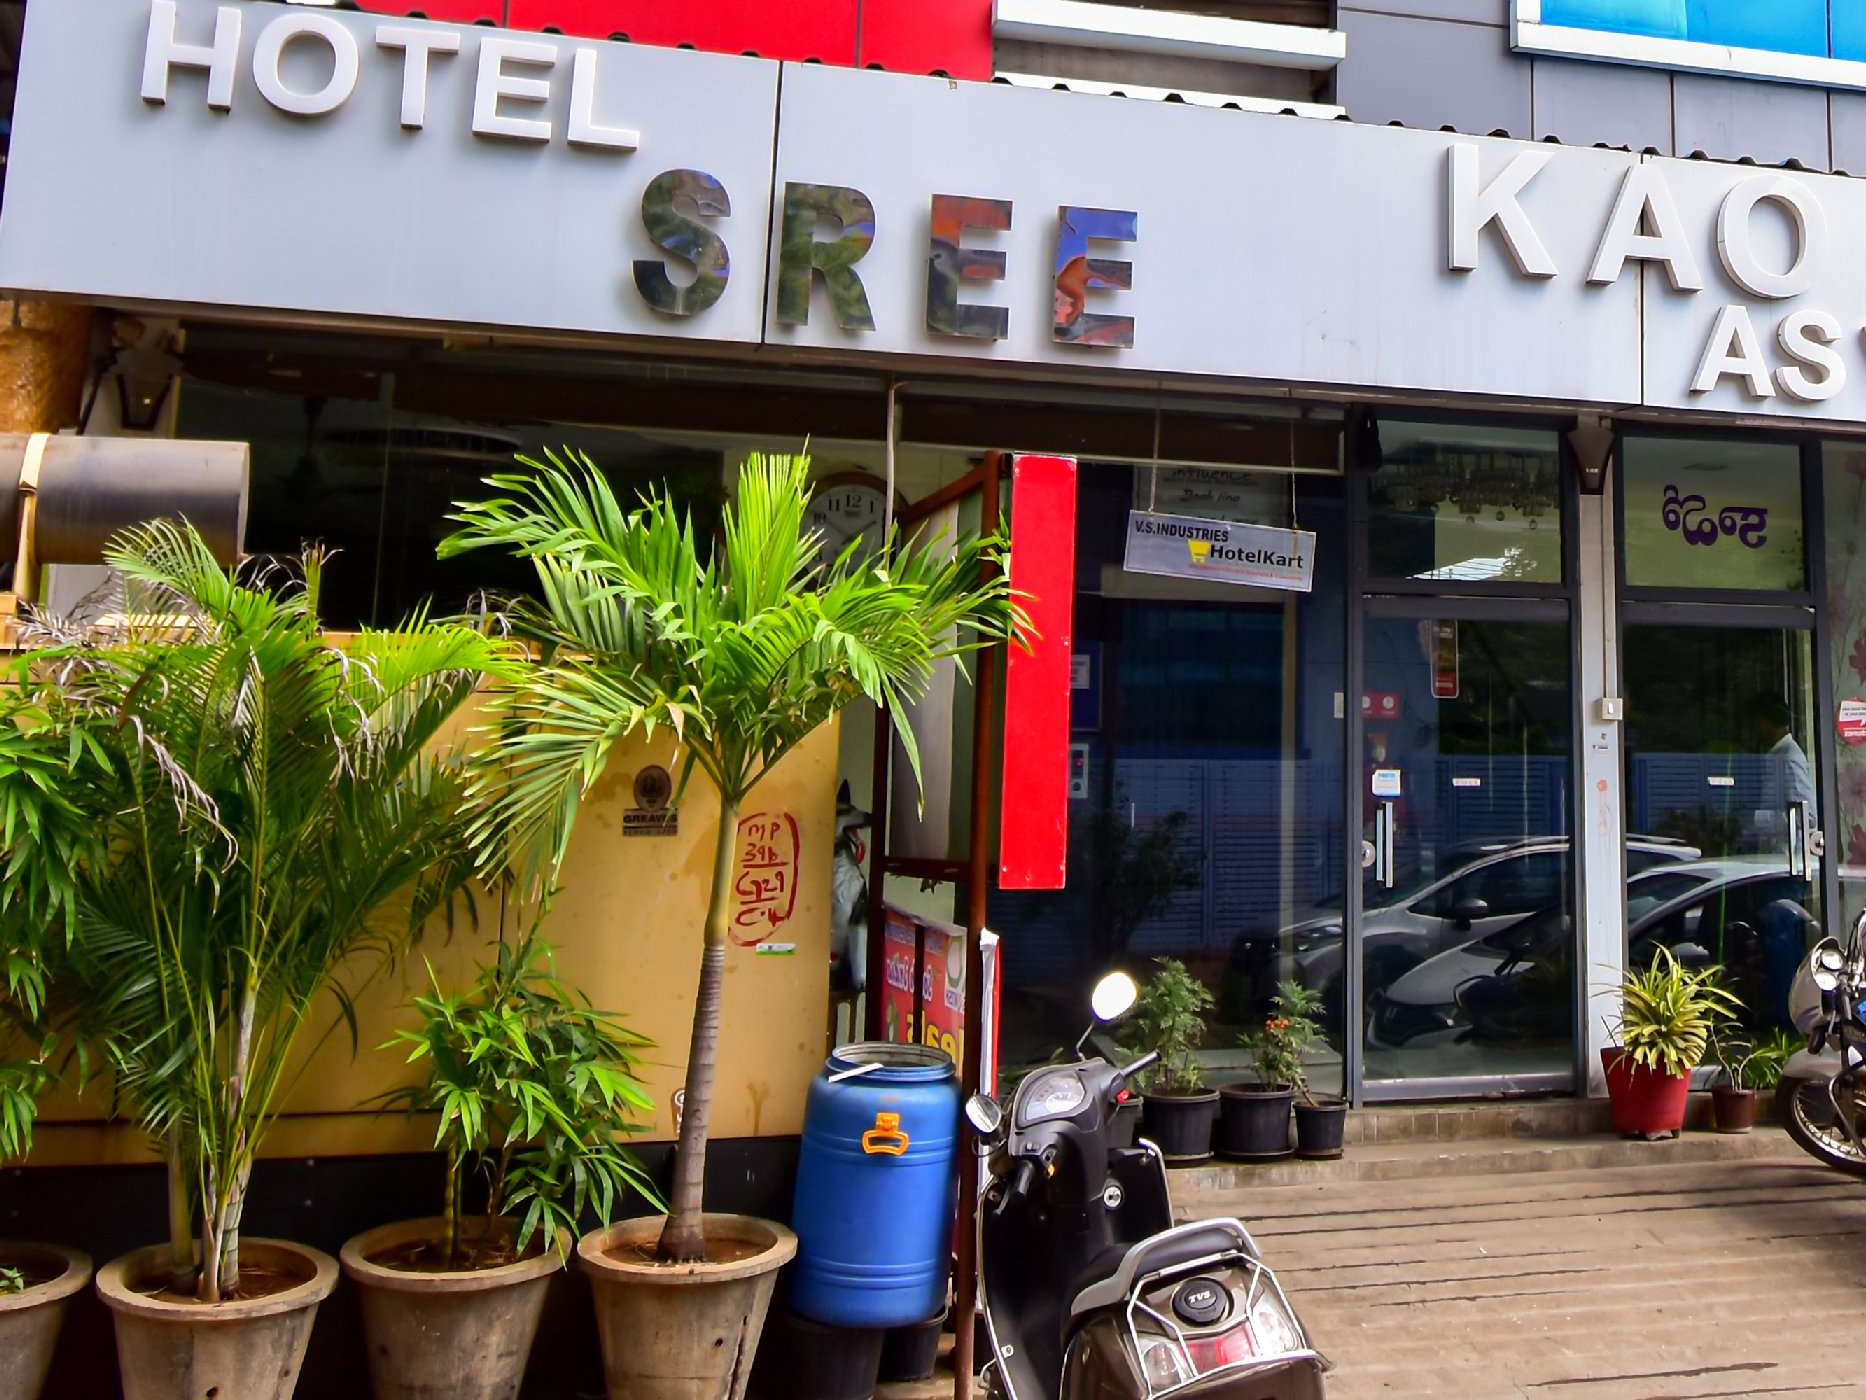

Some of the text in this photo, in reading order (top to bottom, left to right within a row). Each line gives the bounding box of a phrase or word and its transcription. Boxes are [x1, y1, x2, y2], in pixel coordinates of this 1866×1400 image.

[140, 0, 640, 151] HOTEL
[1448, 143, 1826, 299] KAO
[632, 168, 1138, 348] SREE
[846, 494, 862, 508] 12
[1135, 520, 1229, 543] V.S.INDUSTRIES
[1210, 544, 1304, 569] HotelKart
[1188, 1290, 1211, 1303] TVS
